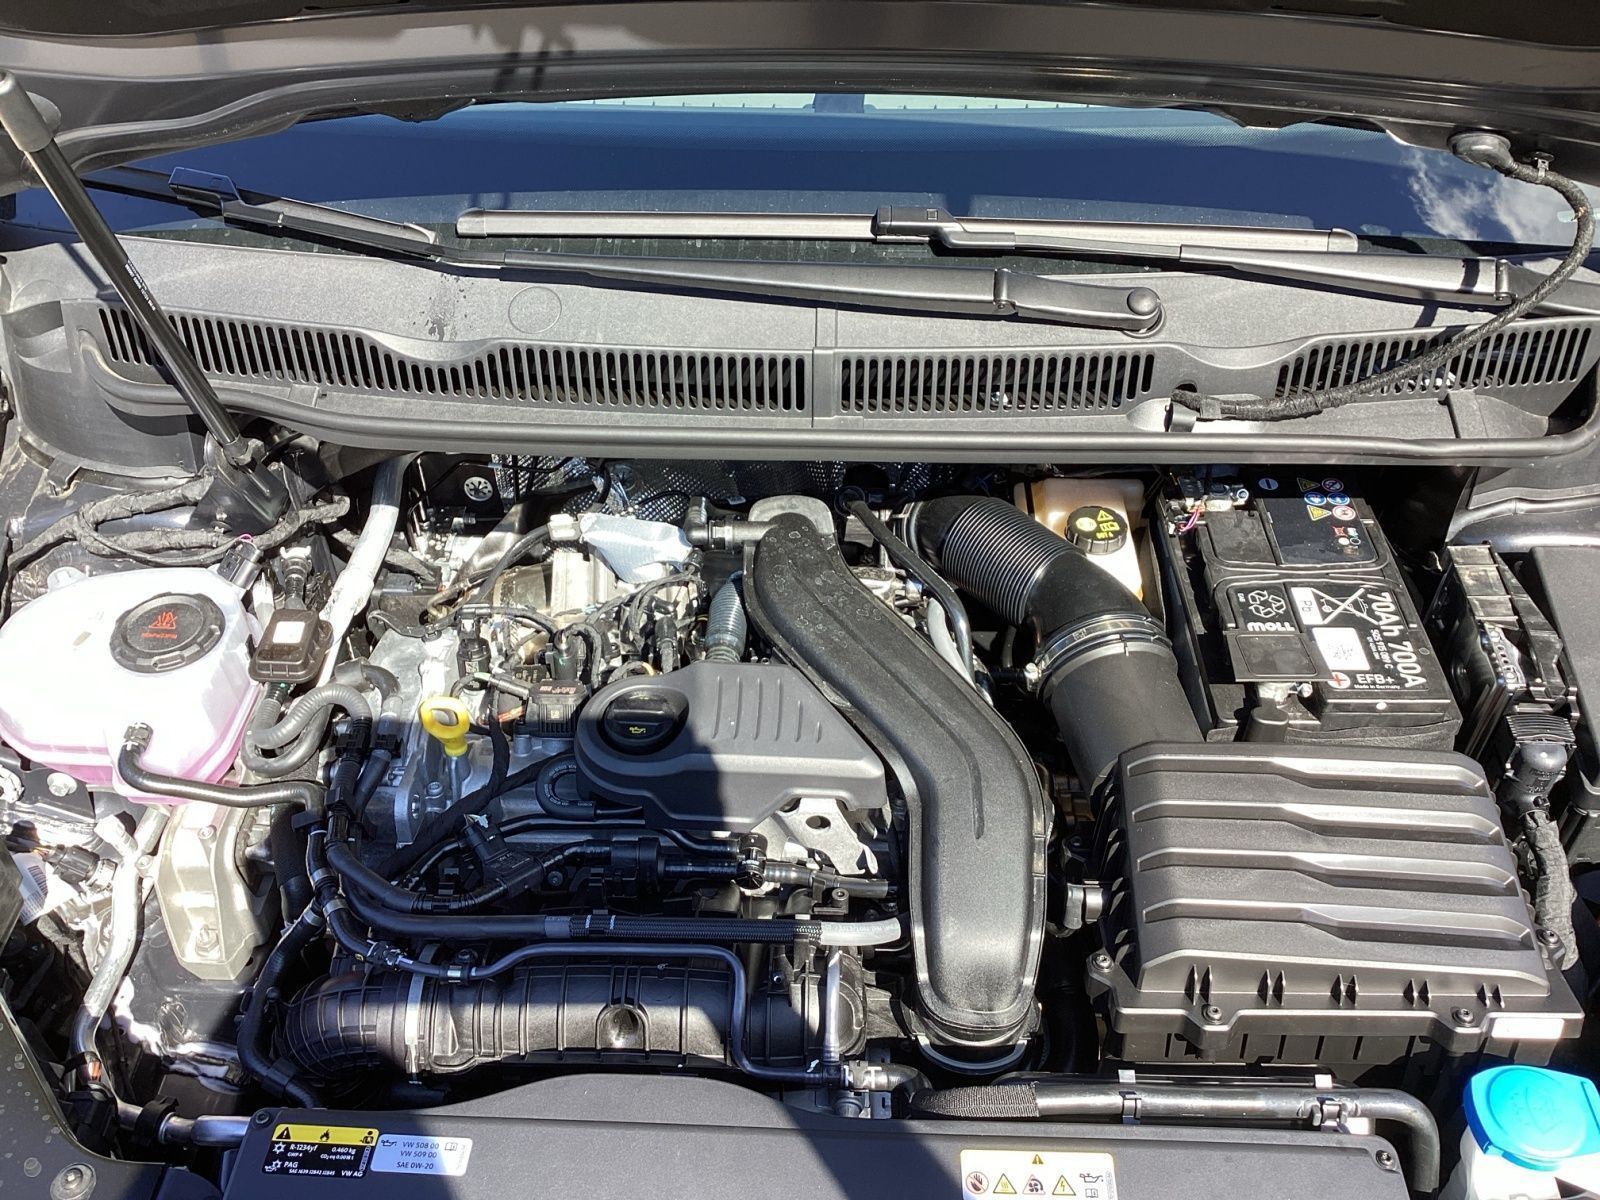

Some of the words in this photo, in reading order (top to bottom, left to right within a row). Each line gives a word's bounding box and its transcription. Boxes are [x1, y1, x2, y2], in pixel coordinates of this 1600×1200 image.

[1367, 592, 1404, 636] 70Ah
[1388, 641, 1427, 688] 700A
[1356, 674, 1395, 684] EFB+
[290, 1144, 319, 1152] R-1234yf
